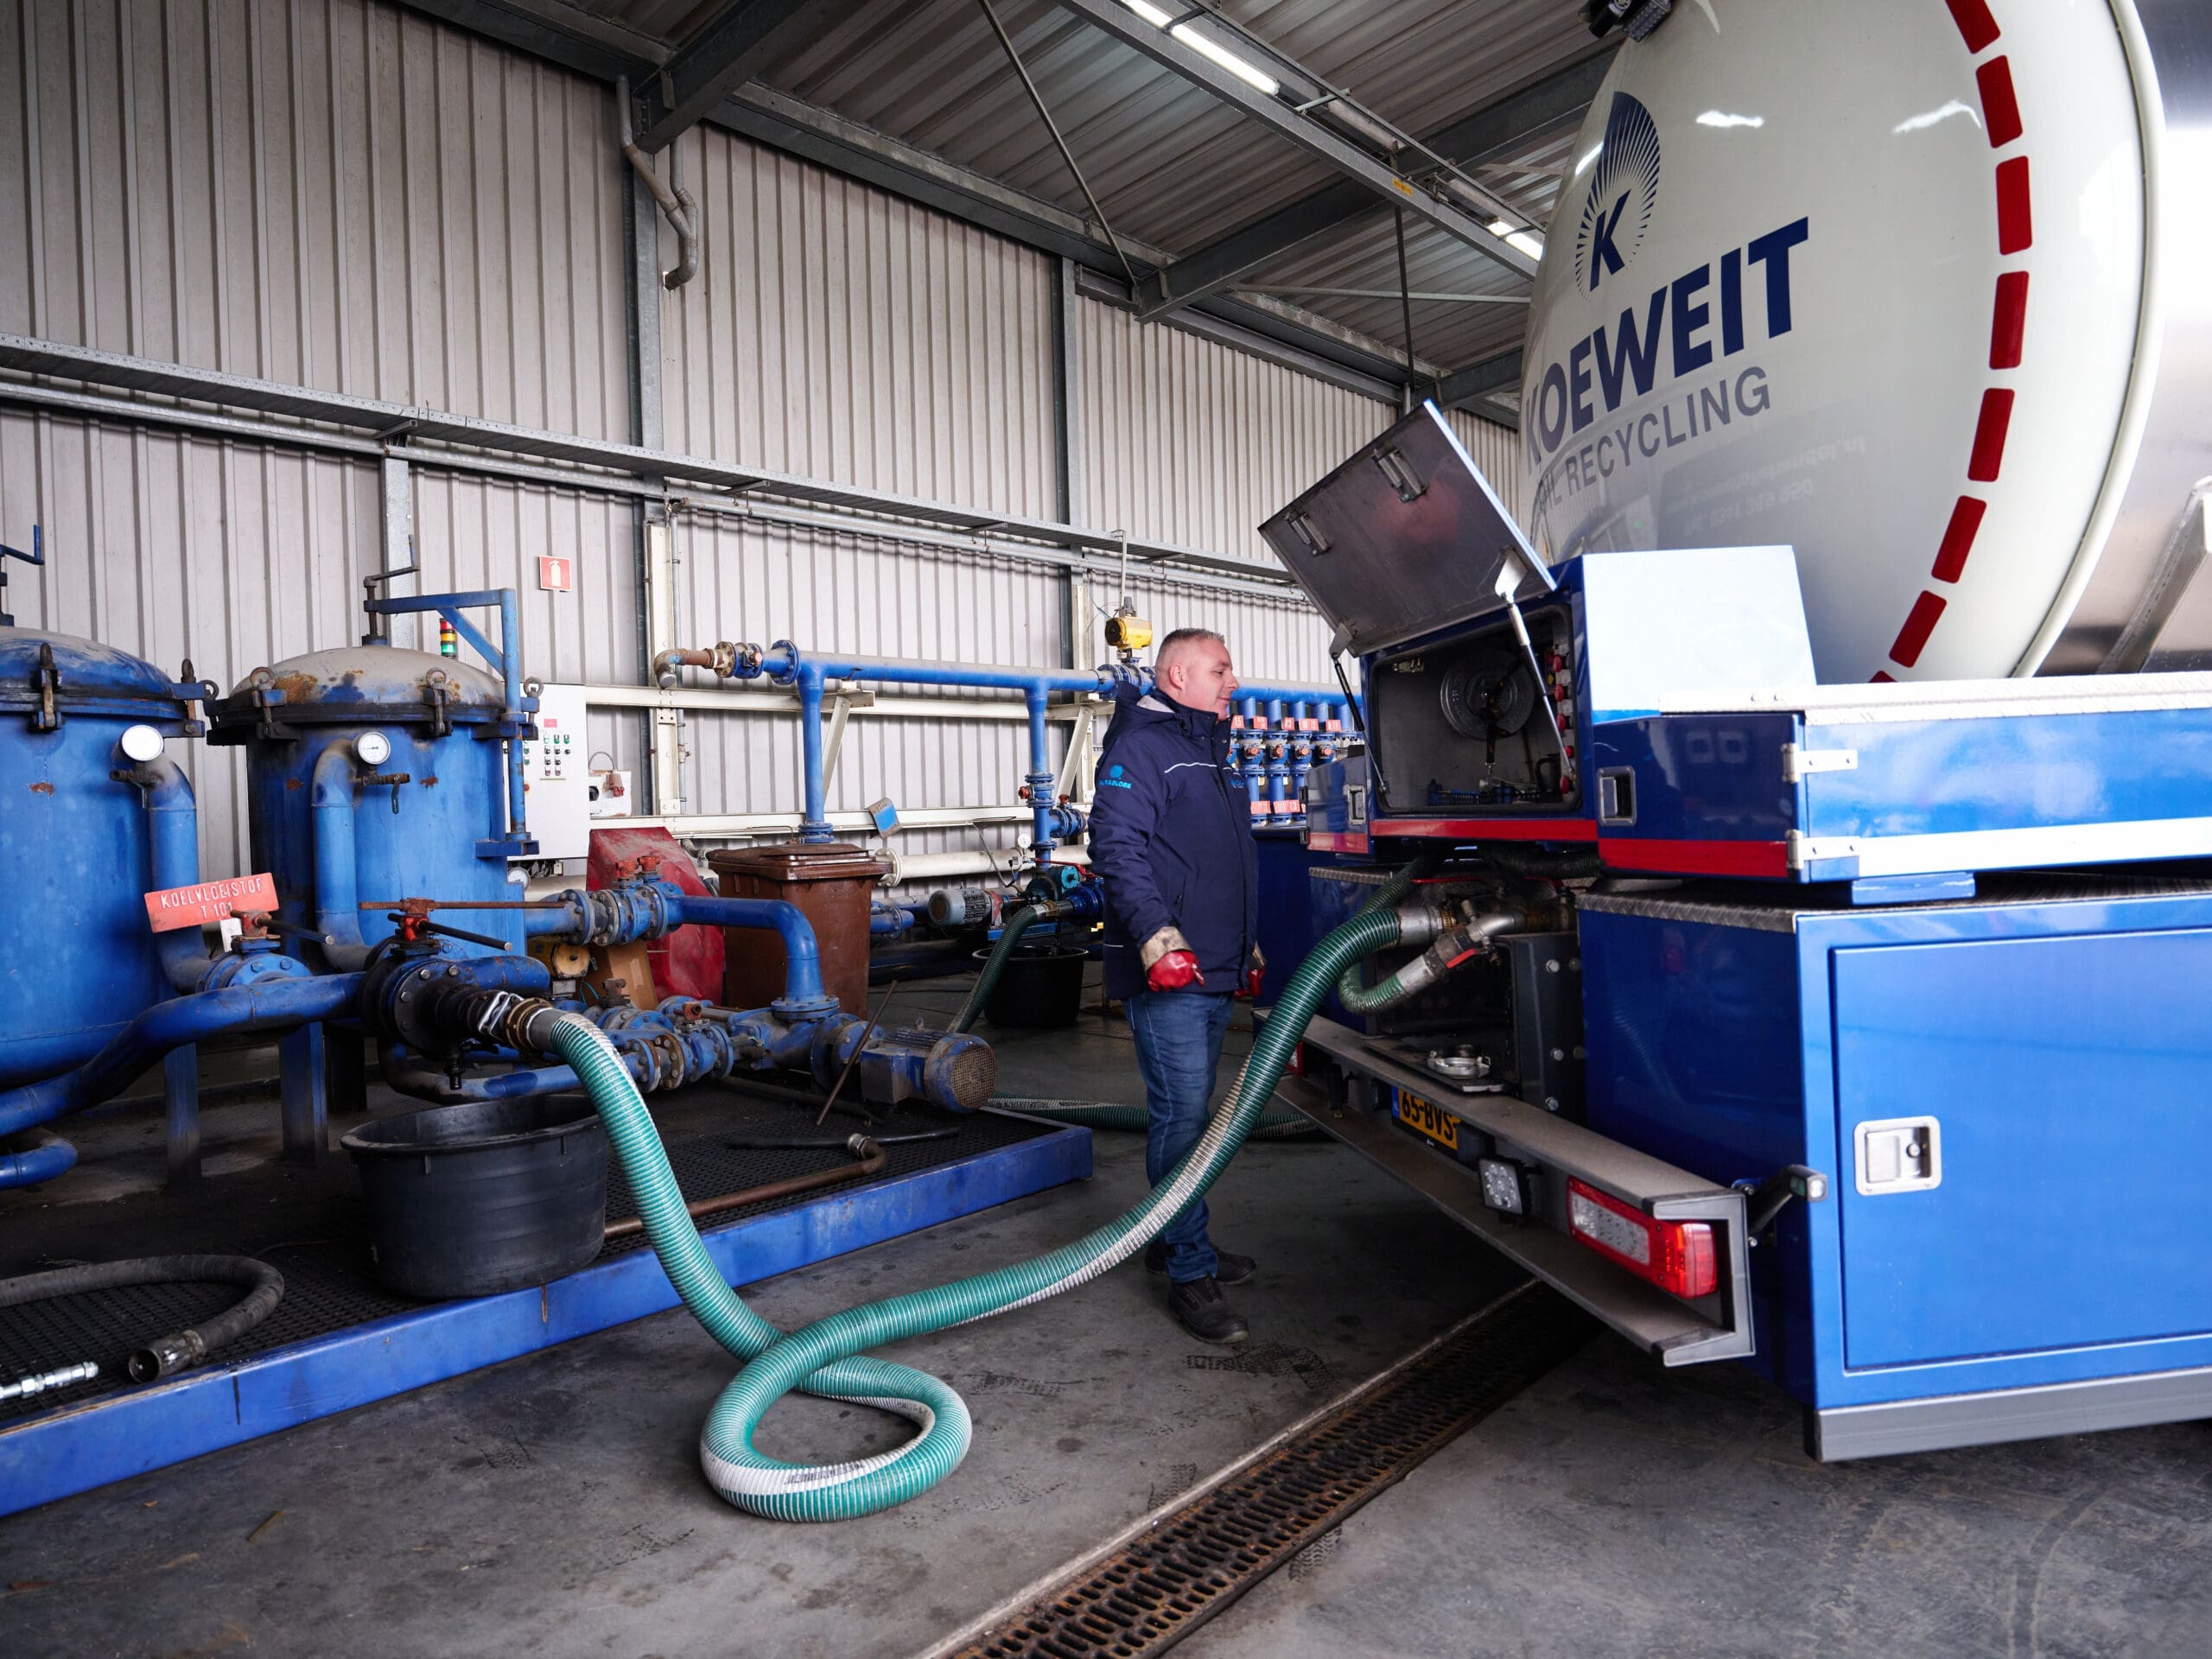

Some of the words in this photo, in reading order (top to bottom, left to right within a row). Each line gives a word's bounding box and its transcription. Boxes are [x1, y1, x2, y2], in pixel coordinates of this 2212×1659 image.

[1590, 189, 1631, 291] K
[1526, 216, 1808, 477] KOEWEIT
[1565, 366, 1771, 496] RECYCLING
[160, 877, 264, 909] KOELVLOEISTOF
[200, 904, 208, 919] T
[213, 901, 233, 918] 101
